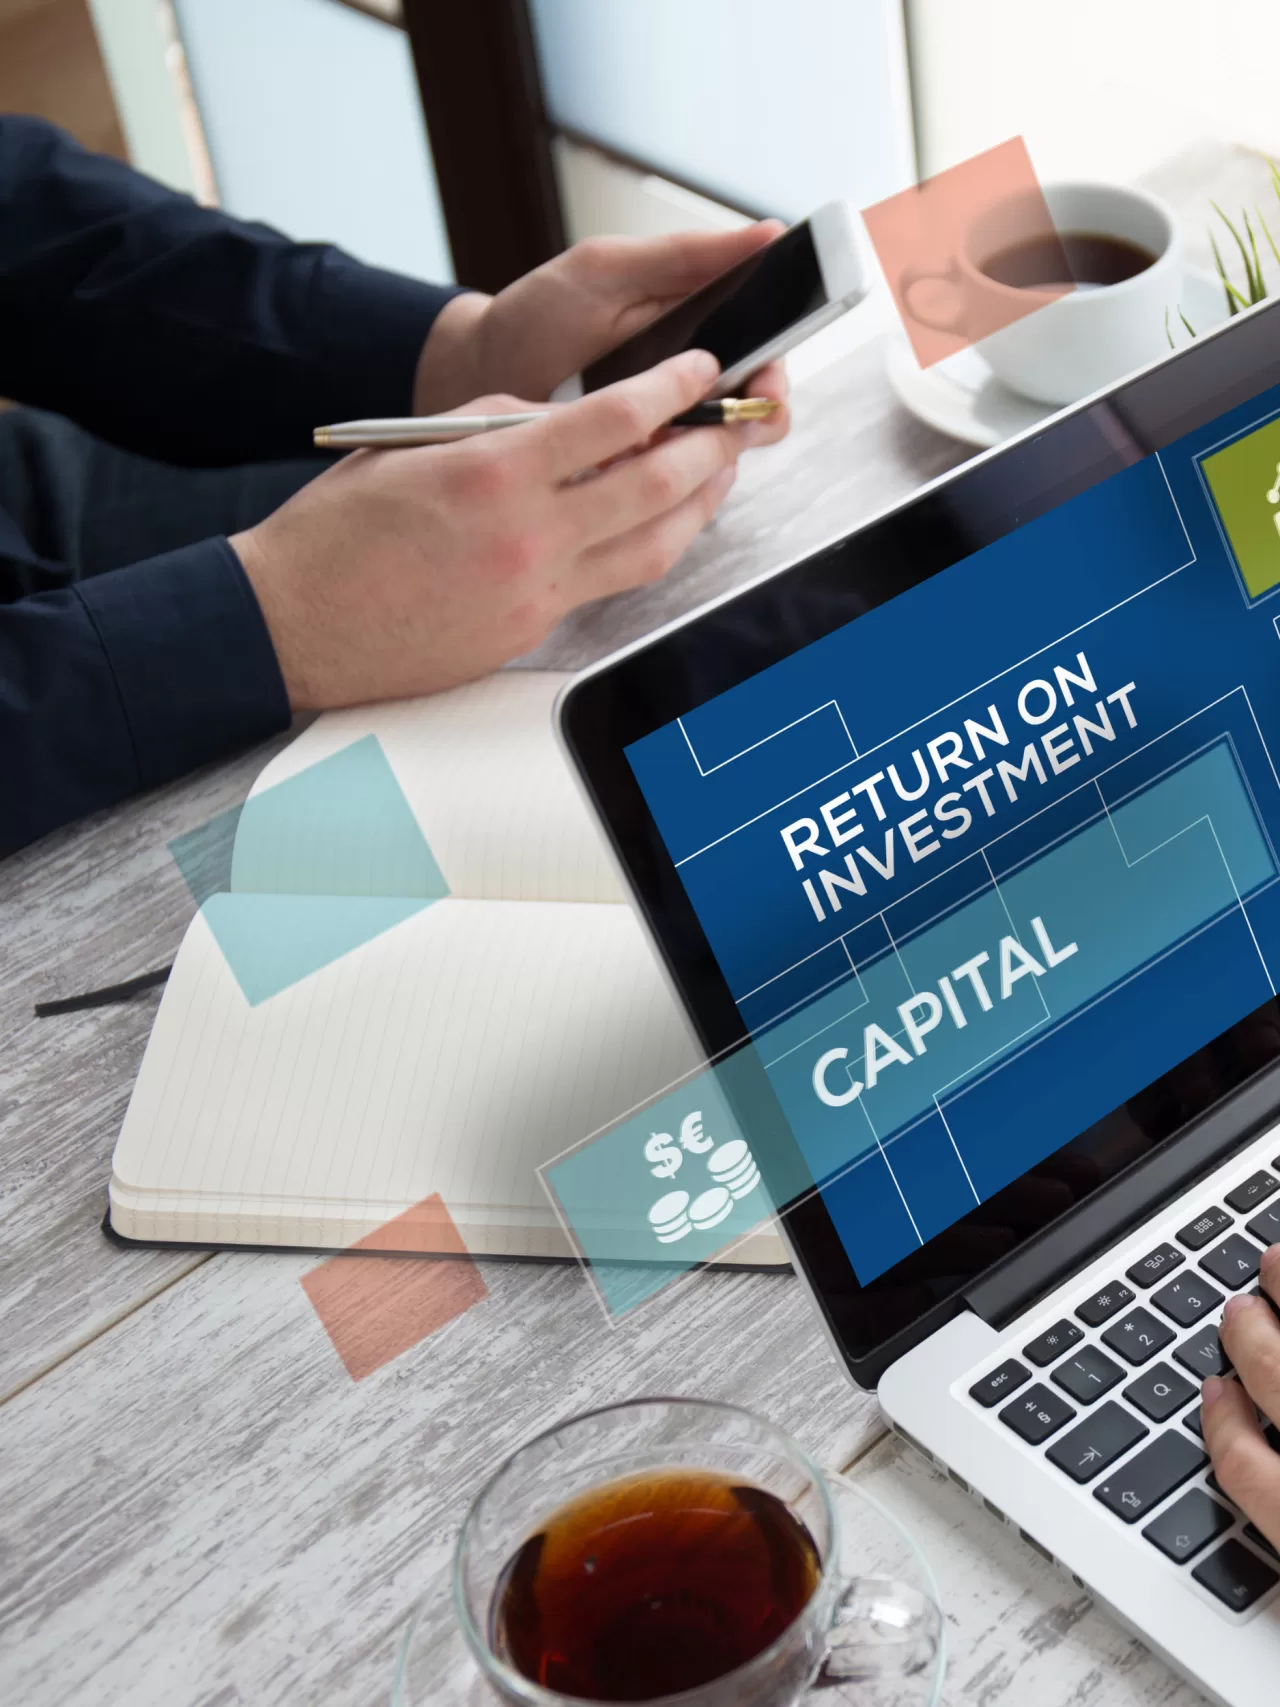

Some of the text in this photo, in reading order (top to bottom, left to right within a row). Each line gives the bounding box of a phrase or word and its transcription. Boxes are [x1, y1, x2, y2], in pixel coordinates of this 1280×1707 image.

[779, 651, 1098, 872] RETURN ON
[801, 681, 1139, 923] INVESTMENT
[1264, 1177, 1275, 1188] F5
[1216, 1214, 1228, 1224] F4
[1168, 1250, 1180, 1260] F3
[1237, 1259, 1250, 1270] 4
[1118, 1288, 1129, 1299] F2
[1187, 1296, 1202, 1308] 3
[1068, 1327, 1078, 1337] F1
[1138, 1334, 1154, 1346] 2
[1199, 1342, 1218, 1360] W
[990, 1372, 1009, 1388] esc
[1088, 1373, 1102, 1383] 1
[1153, 1383, 1172, 1397] Q
